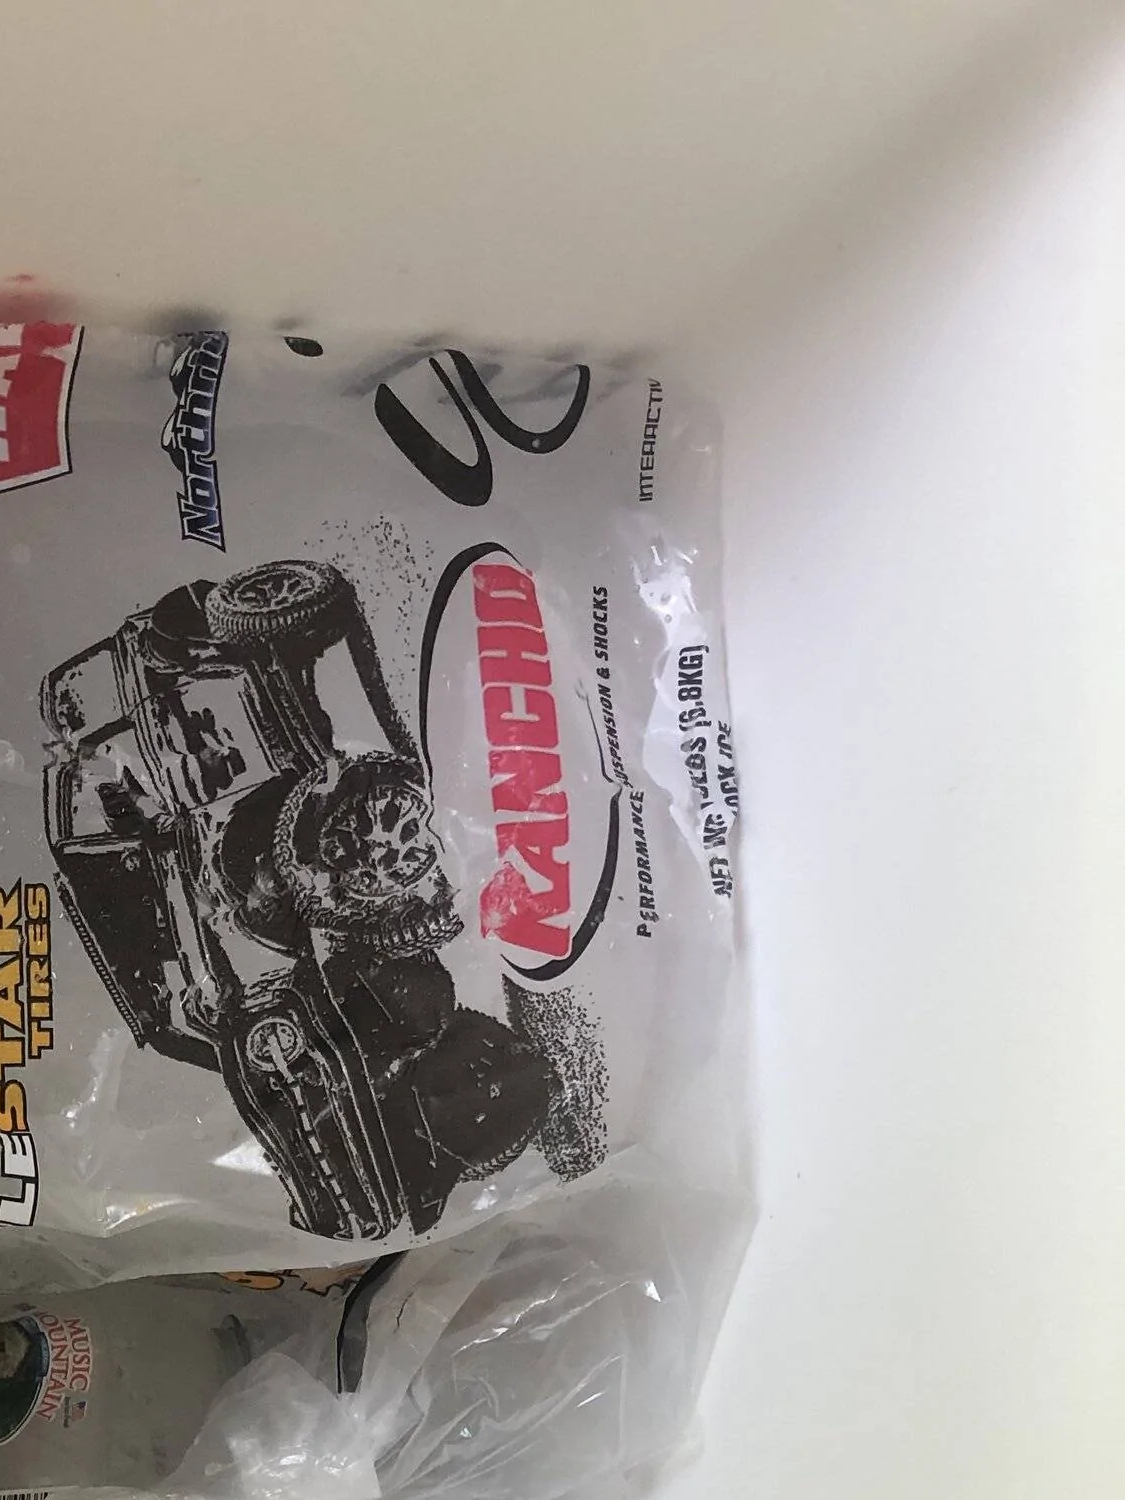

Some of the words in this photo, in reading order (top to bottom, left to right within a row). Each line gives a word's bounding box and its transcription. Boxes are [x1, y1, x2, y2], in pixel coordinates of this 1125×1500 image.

[592, 585, 609, 661] SHOCKS
[598, 668, 612, 681] &
[471, 562, 573, 958] RANCHO
[635, 790, 656, 938] PERFORMANCE
[22, 882, 54, 1060] TIRES
[63, 1316, 91, 1392] MUSIC
